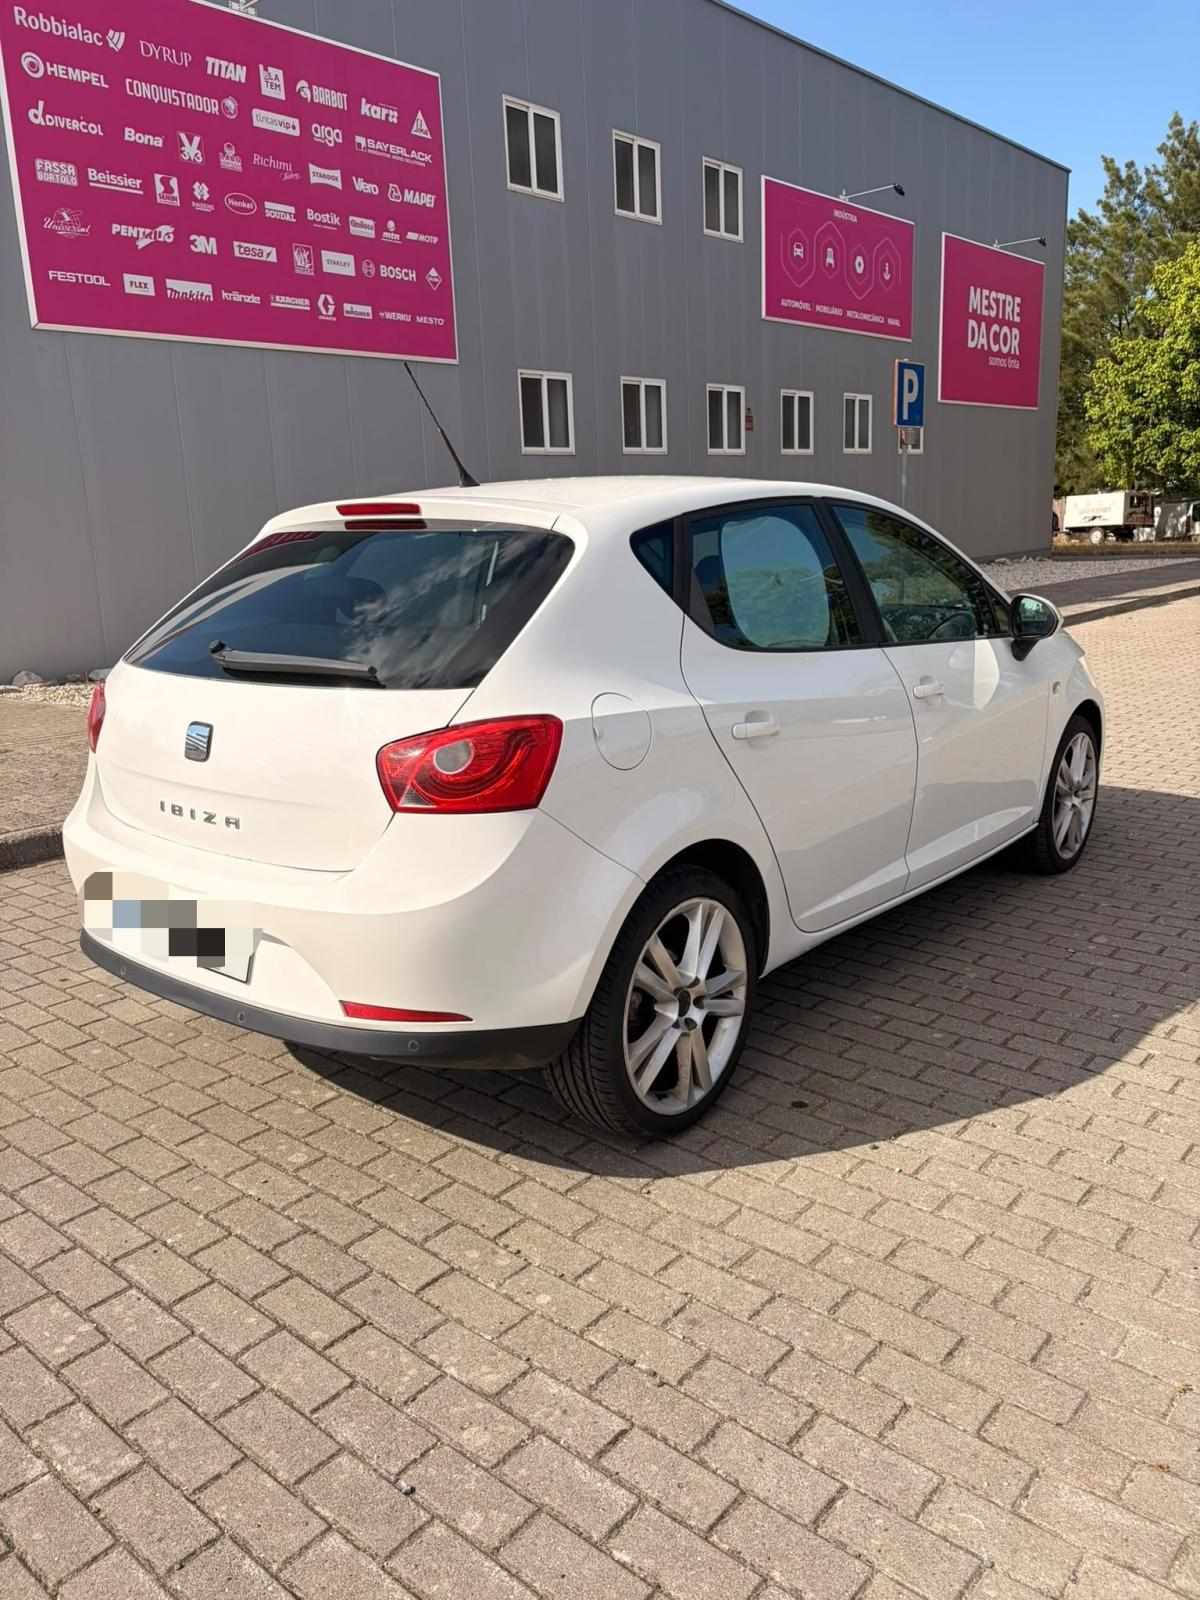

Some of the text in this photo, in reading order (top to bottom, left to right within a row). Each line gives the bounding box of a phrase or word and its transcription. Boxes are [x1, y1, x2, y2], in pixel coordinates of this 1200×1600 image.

[14, 6, 103, 46] Robbialac
[140, 40, 192, 67] DYRUP
[46, 62, 109, 88] HEMPEL
[205, 56, 247, 83] TITAN
[125, 78, 220, 115] CONQUISTADOR
[312, 85, 348, 111] BARBOT
[124, 127, 164, 148] Bona
[367, 138, 433, 164] SAYERLACK
[88, 167, 142, 189] Beissier
[306, 207, 341, 226] Bostik
[190, 234, 217, 256] 3M
[238, 244, 264, 258] tesa
[48, 270, 111, 287] FESTOOL
[129, 280, 149, 290] FLEX
[380, 264, 416, 282] BOSCH
[969, 286, 1021, 322] MESTRE
[967, 319, 1020, 355] DA COR
[903, 368, 919, 420] P
[159, 800, 241, 830] IBIZA
